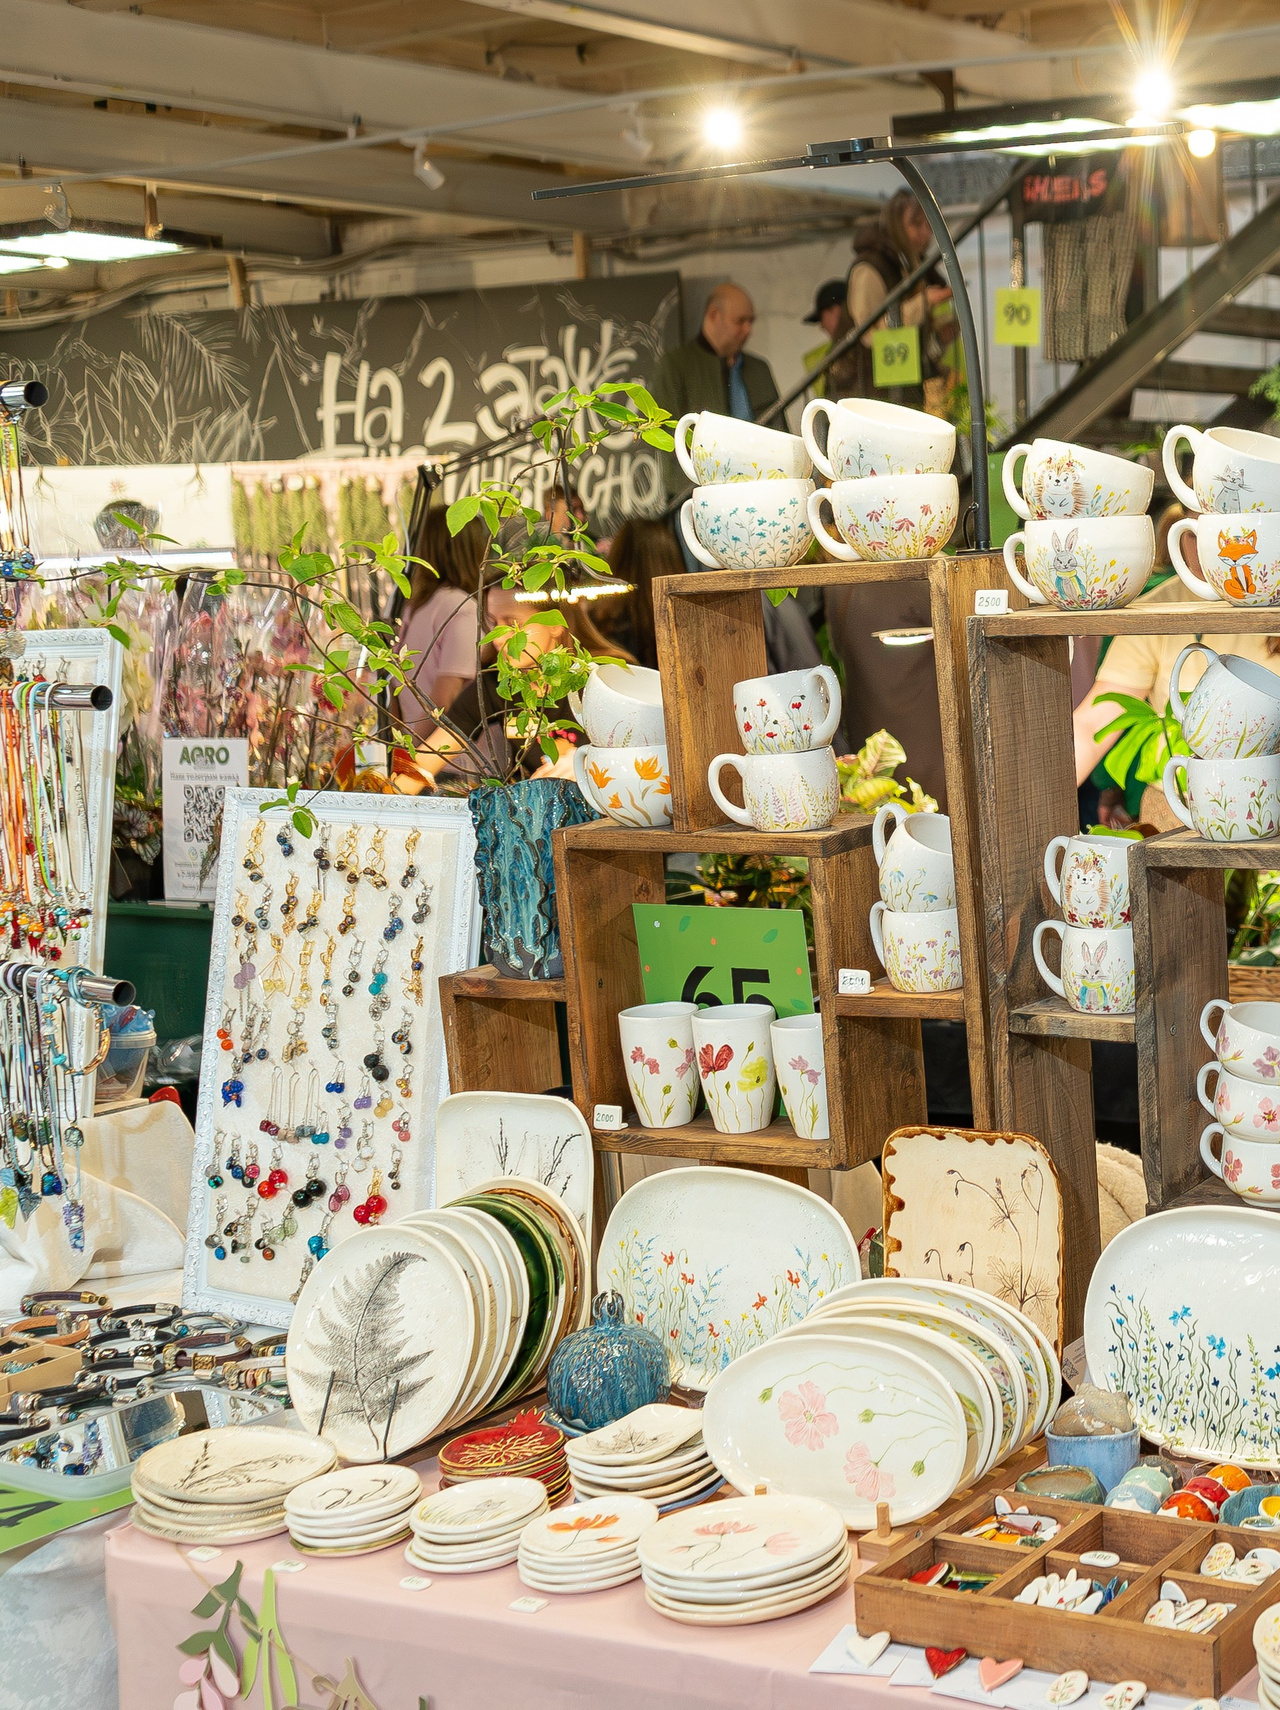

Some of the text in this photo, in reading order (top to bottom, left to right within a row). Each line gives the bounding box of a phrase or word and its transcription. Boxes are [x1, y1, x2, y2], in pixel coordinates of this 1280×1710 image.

[1003, 302, 1031, 325] 90
[882, 342, 910, 367] 89
[316, 351, 404, 451] На
[417, 356, 478, 448] 2
[978, 596, 1001, 607] 2500
